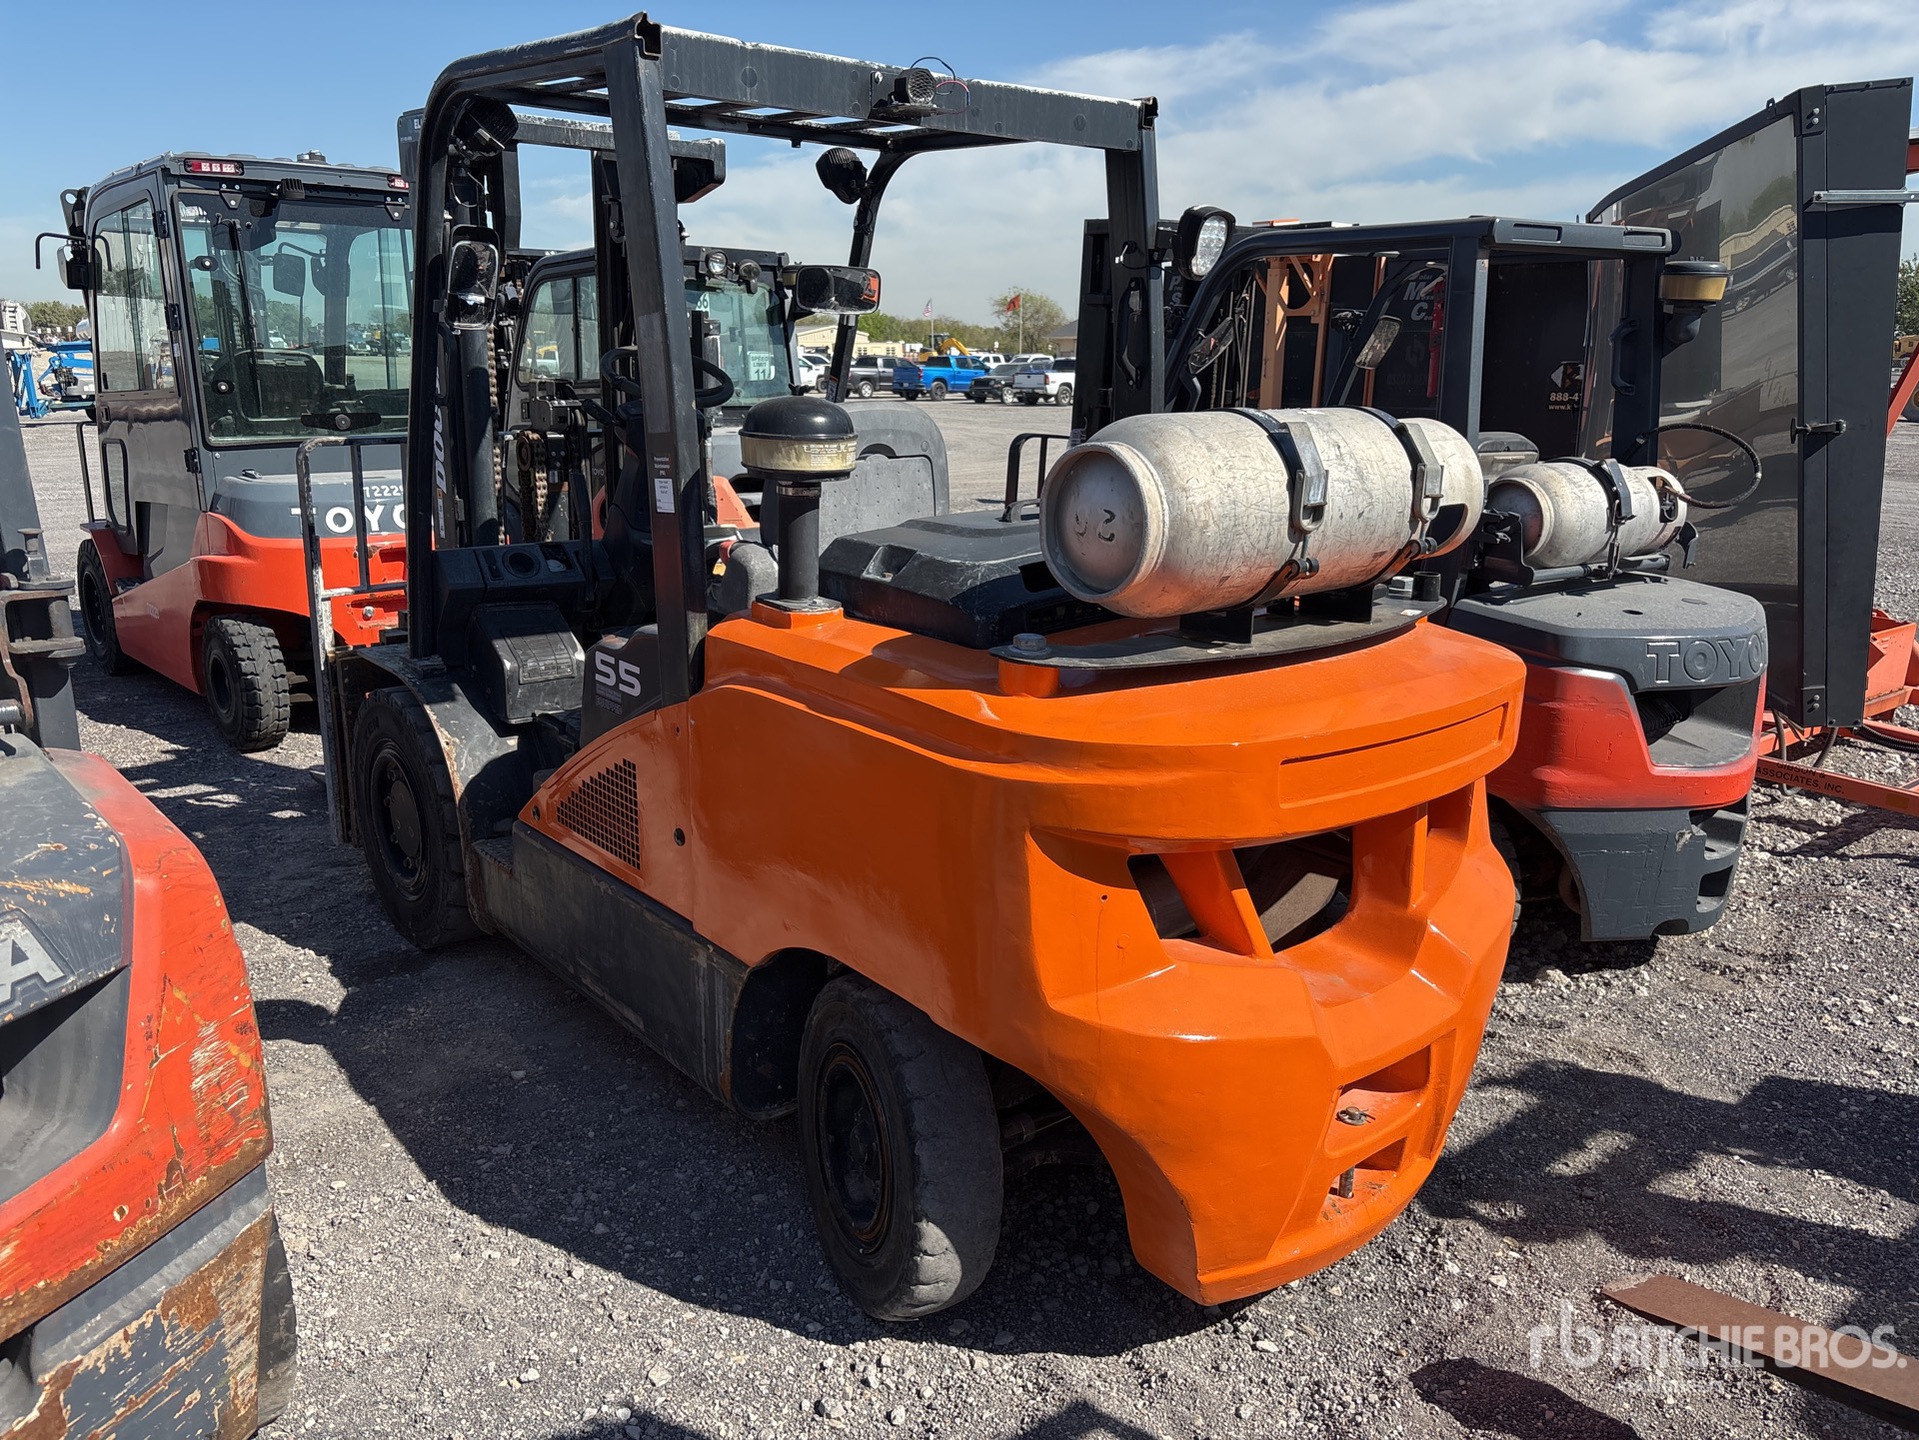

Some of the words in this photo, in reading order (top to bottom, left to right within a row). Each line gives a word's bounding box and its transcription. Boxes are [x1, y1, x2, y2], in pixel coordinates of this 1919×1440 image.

[1549, 392, 1581, 402] 888-4
[1646, 632, 1767, 683] TOYO
[1824, 782, 1845, 795] INC.
